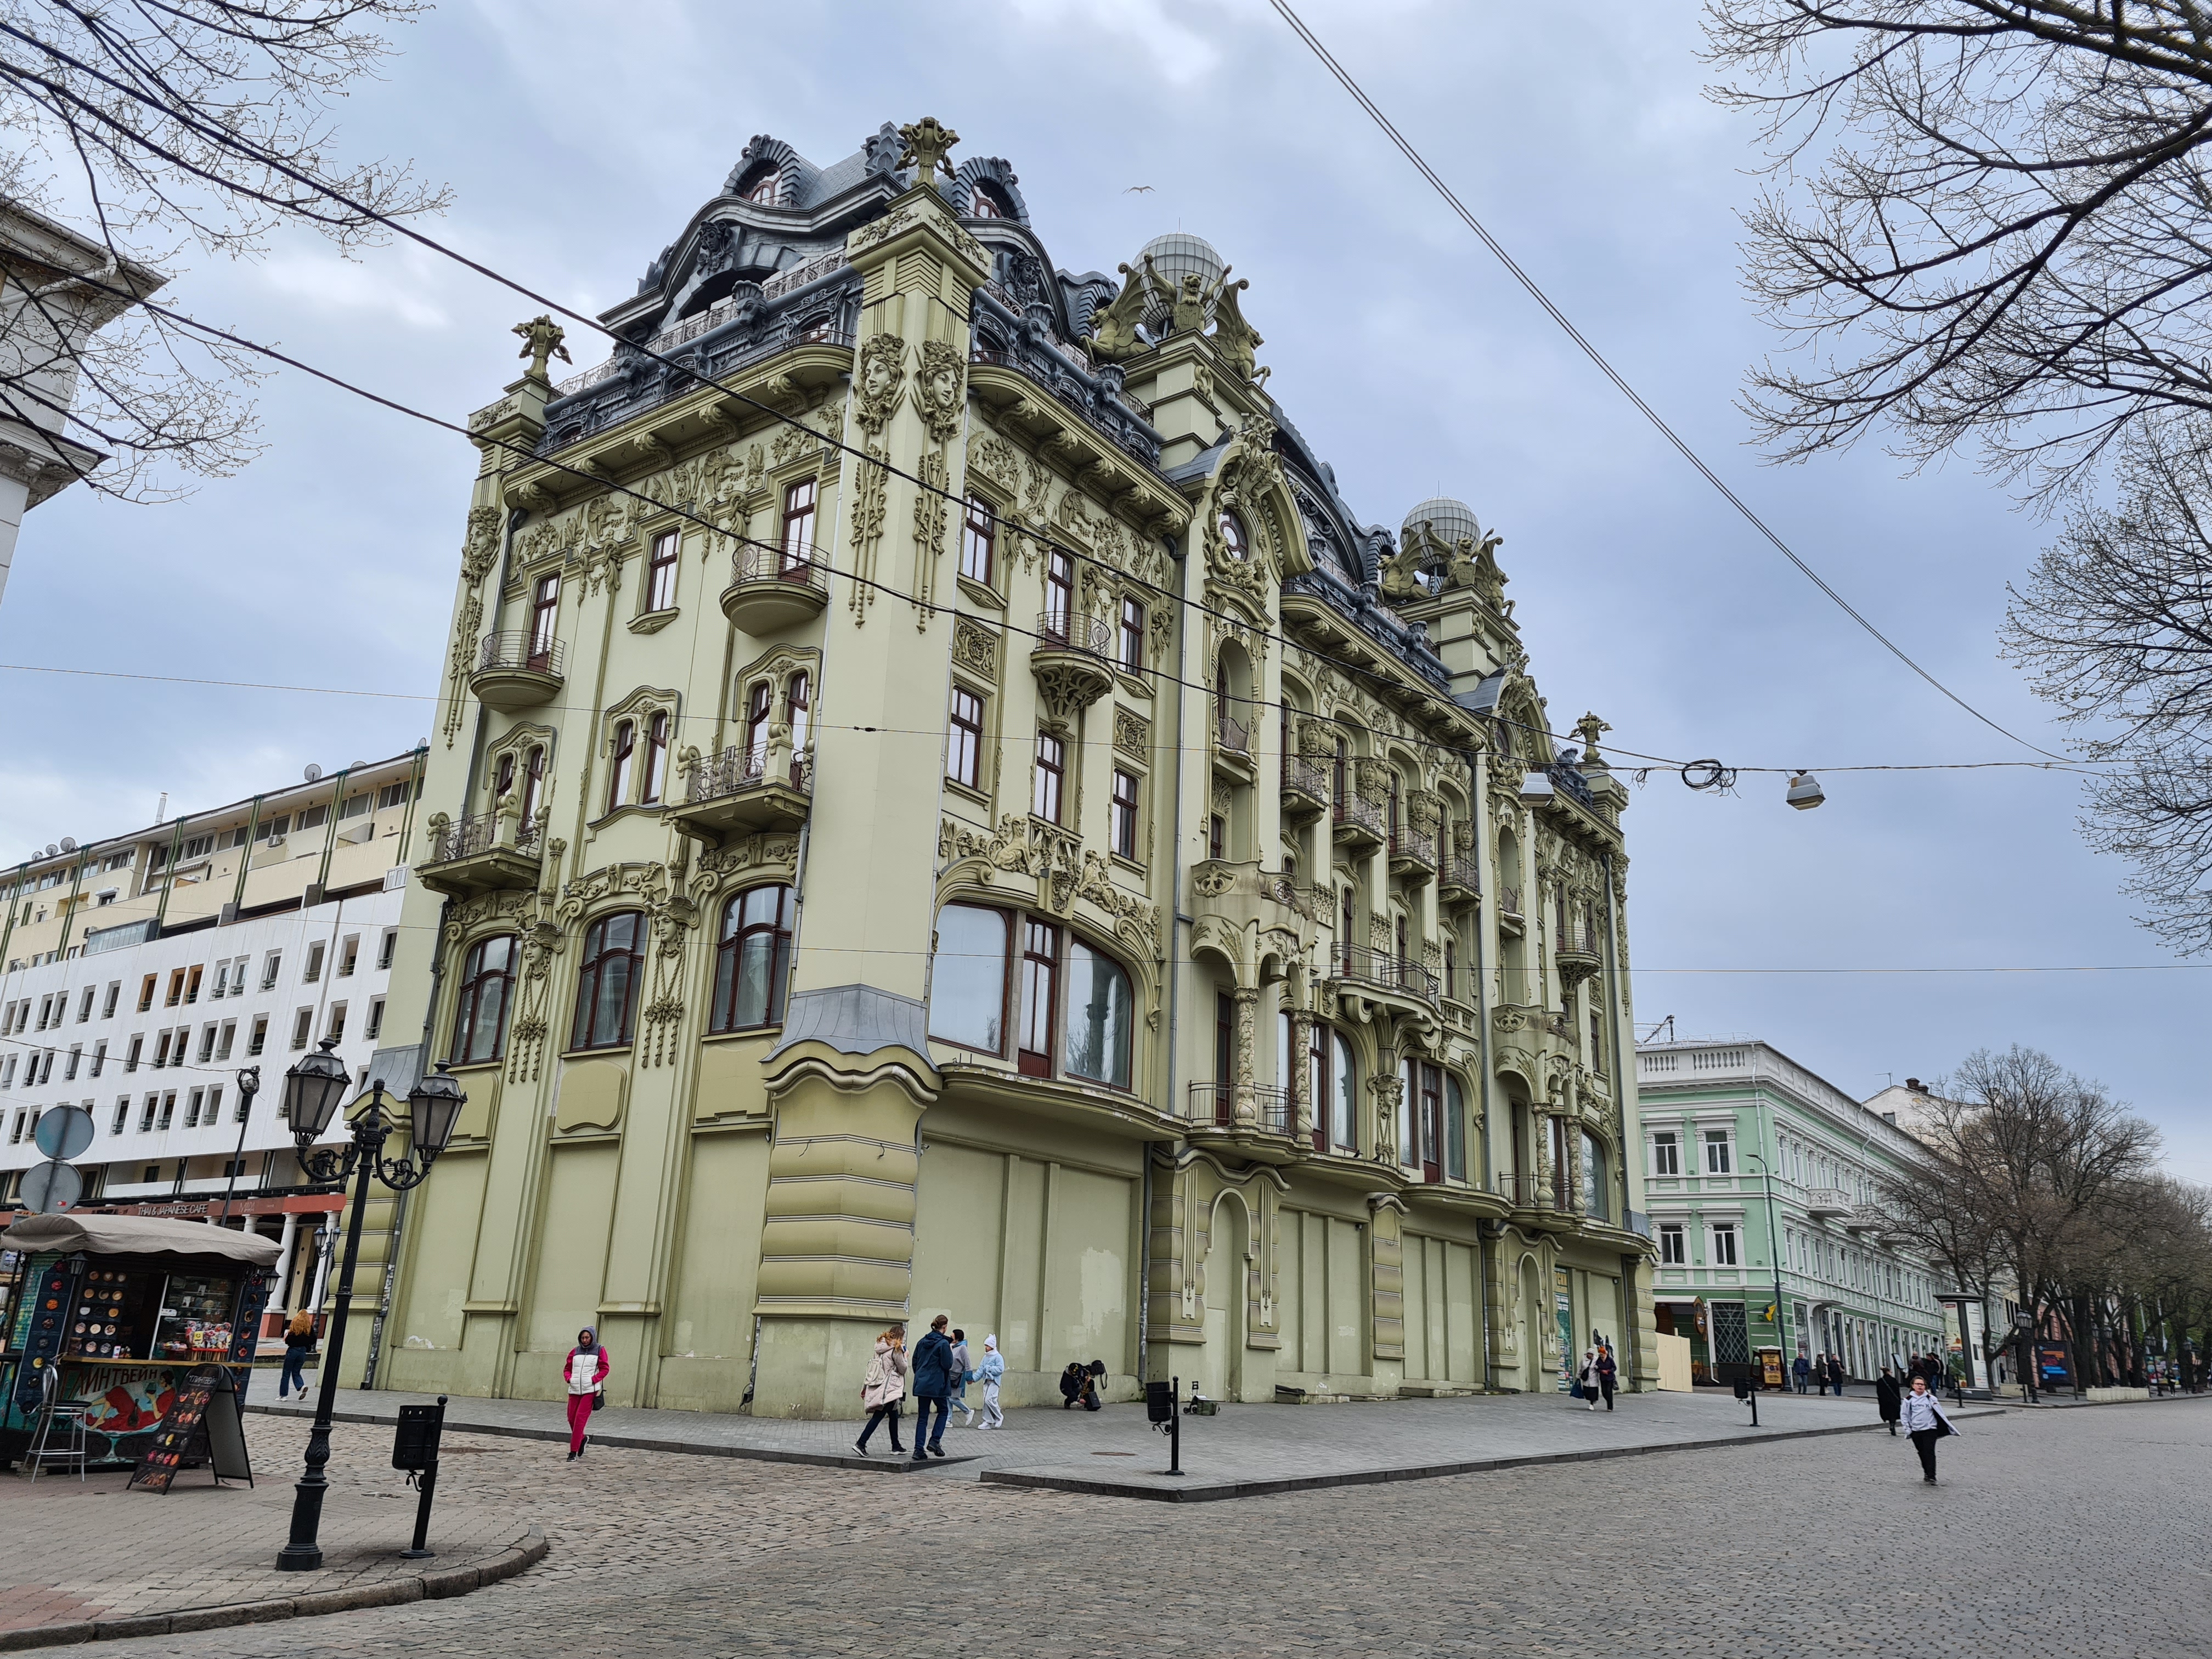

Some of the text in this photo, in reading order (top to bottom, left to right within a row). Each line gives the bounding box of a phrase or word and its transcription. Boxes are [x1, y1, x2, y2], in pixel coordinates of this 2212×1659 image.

[157, 1205, 190, 1215] JAPANESE
[189, 1204, 208, 1214] CAFE
[59, 1365, 158, 1401] ГЛИНТВЕЙН
